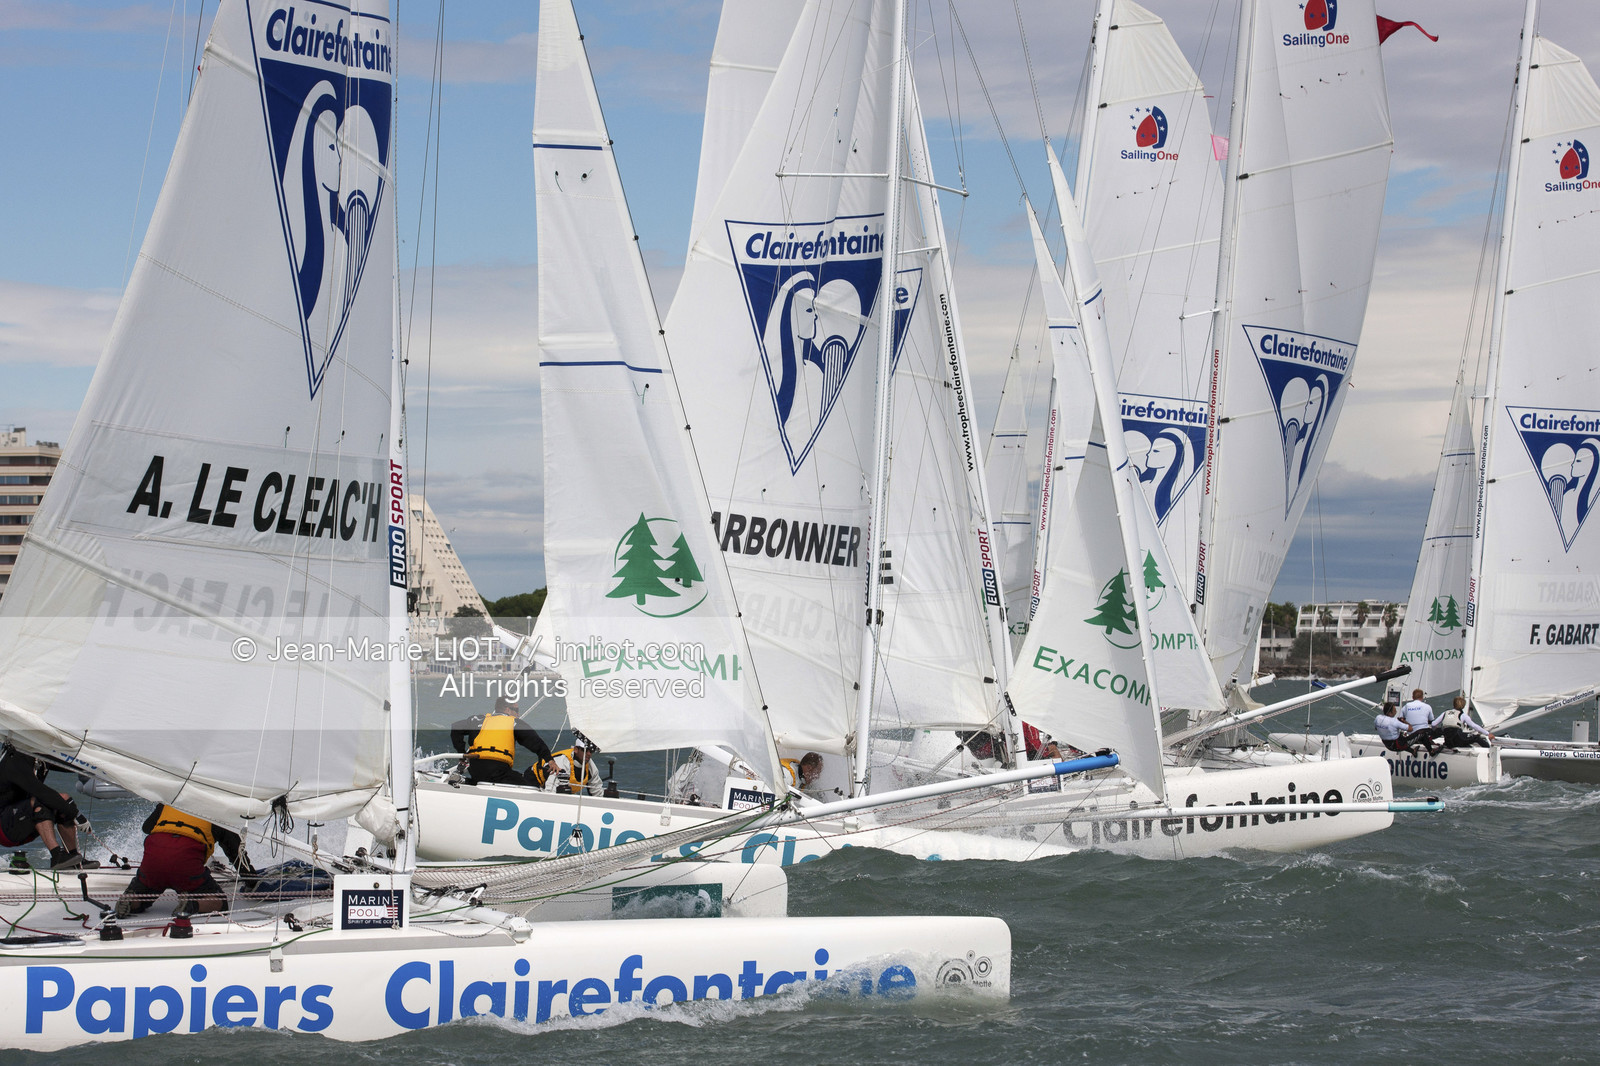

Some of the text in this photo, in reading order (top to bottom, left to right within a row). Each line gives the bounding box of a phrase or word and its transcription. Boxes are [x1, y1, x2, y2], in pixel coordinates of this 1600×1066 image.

[1283, 32, 1349, 48] SailingOne
[1120, 149, 1179, 163] SailingOne
[1260, 333, 1348, 371] Clairefontaine
[939, 293, 974, 472] www.tropheeclairefontaine.com
[1205, 349, 1220, 496] www.tropheeclairefontaine.com
[1040, 409, 1057, 531] www.tropheeclairefontaine.com
[1475, 425, 1489, 539] www.tropheeclairefontaine.com
[126, 455, 383, 543] A. LE CLEAC'H
[1530, 623, 1599, 645] F. GABART
[348, 894, 399, 905] MARINE
[349, 908, 379, 917] POOL
[25, 963, 334, 1039] Papiers
